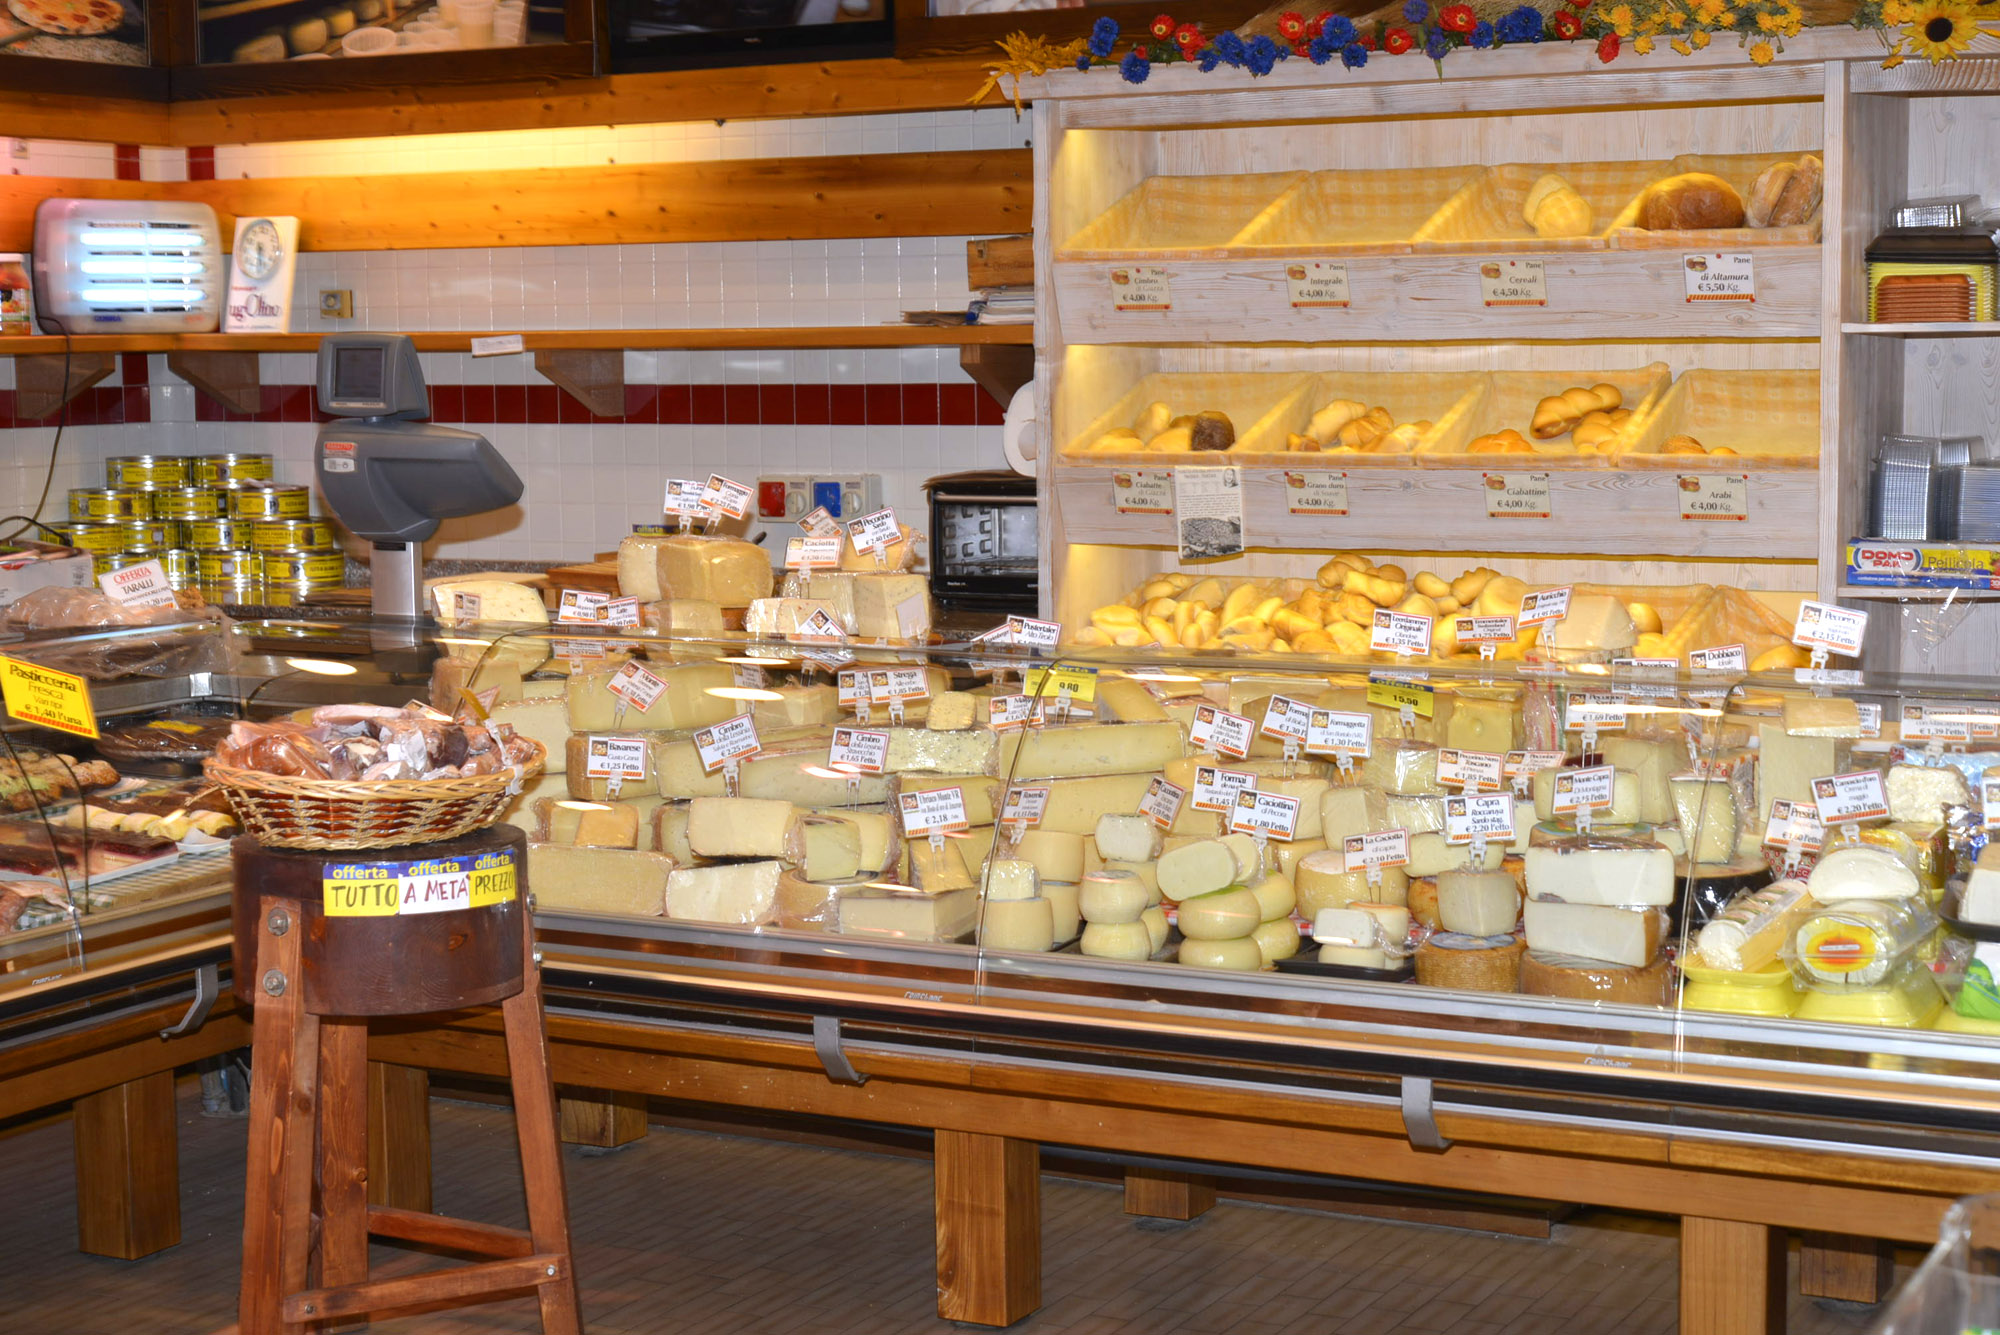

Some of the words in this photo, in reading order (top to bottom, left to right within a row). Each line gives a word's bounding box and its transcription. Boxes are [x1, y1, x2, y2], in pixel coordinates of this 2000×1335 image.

[1525, 261, 1541, 269] Pane
[1733, 256, 1751, 264] Pane
[1310, 277, 1343, 286] Integrale
[1508, 275, 1537, 284] Cereali
[1700, 273, 1709, 281] di
[1710, 273, 1749, 281] Altamura
[1500, 288, 1519, 298] 4,50
[1706, 283, 1725, 292] 5,50
[1530, 474, 1546, 482] Pane
[1726, 476, 1743, 484] Pane
[1506, 488, 1547, 496] Ciabattine
[1709, 491, 1732, 499] Arabi
[1504, 499, 1523, 509] 4,00
[1698, 501, 1718, 511] 4,00
[1861, 549, 1914, 560] DOMO
[113, 566, 153, 585] OFFERTA
[1392, 615, 1428, 626] Leerdammer
[1024, 622, 1057, 634] Pustertaler
[1818, 630, 1835, 641] 2,15
[1391, 637, 1406, 646] 1,35
[1406, 637, 1425, 648] l'etto
[1707, 649, 1741, 661] Dobbiaco
[1375, 679, 1425, 691] offerta
[28, 681, 65, 701] Fresca
[1393, 694, 1420, 706] 15.50
[1604, 713, 1623, 721] l'etto
[718, 721, 744, 736] Cimbro
[1221, 716, 1243, 730] Piave
[1330, 718, 1366, 729] Formaggetta
[1285, 724, 1300, 736] 1,30
[1944, 726, 1966, 736] l'etto
[856, 733, 881, 744] Cimbro
[1215, 735, 1230, 746] 1,45
[1323, 738, 1330, 746] €
[1330, 738, 1347, 747] 1,30
[1345, 738, 1367, 748] l'etto
[609, 743, 642, 753] Bavarese
[846, 754, 860, 763] 1,65
[859, 755, 877, 765] l'etto
[600, 762, 607, 770] €
[607, 762, 621, 771] 1,25
[621, 763, 640, 771] l'etto
[1220, 771, 1247, 784] Formai
[1461, 772, 1478, 782] 1,85
[1477, 774, 1498, 783] l'etto
[1590, 792, 1608, 802] l'etto
[1258, 796, 1294, 811] Caciottina
[1475, 797, 1500, 809] Capra
[1837, 806, 1843, 815] €
[1844, 804, 1863, 815] 2,20
[1862, 801, 1883, 812] l'etto
[924, 816, 931, 825] €
[931, 813, 949, 824] 2,18
[1247, 818, 1253, 826] €
[1253, 818, 1270, 829] 1,80
[1270, 820, 1289, 832] l'etto
[1465, 825, 1471, 834] €
[1472, 824, 1490, 834] 2,20
[1490, 823, 1511, 832] l'etto
[1365, 836, 1374, 845] La
[1373, 832, 1404, 844] Caciotta
[474, 853, 510, 871] offerta
[1368, 855, 1386, 865] 2,10
[1385, 851, 1406, 861] l'etto
[332, 866, 389, 879] offerta
[408, 860, 460, 877] offerta
[331, 883, 398, 908] TUTTO
[404, 881, 417, 904] A
[474, 871, 515, 896] PREZZO
